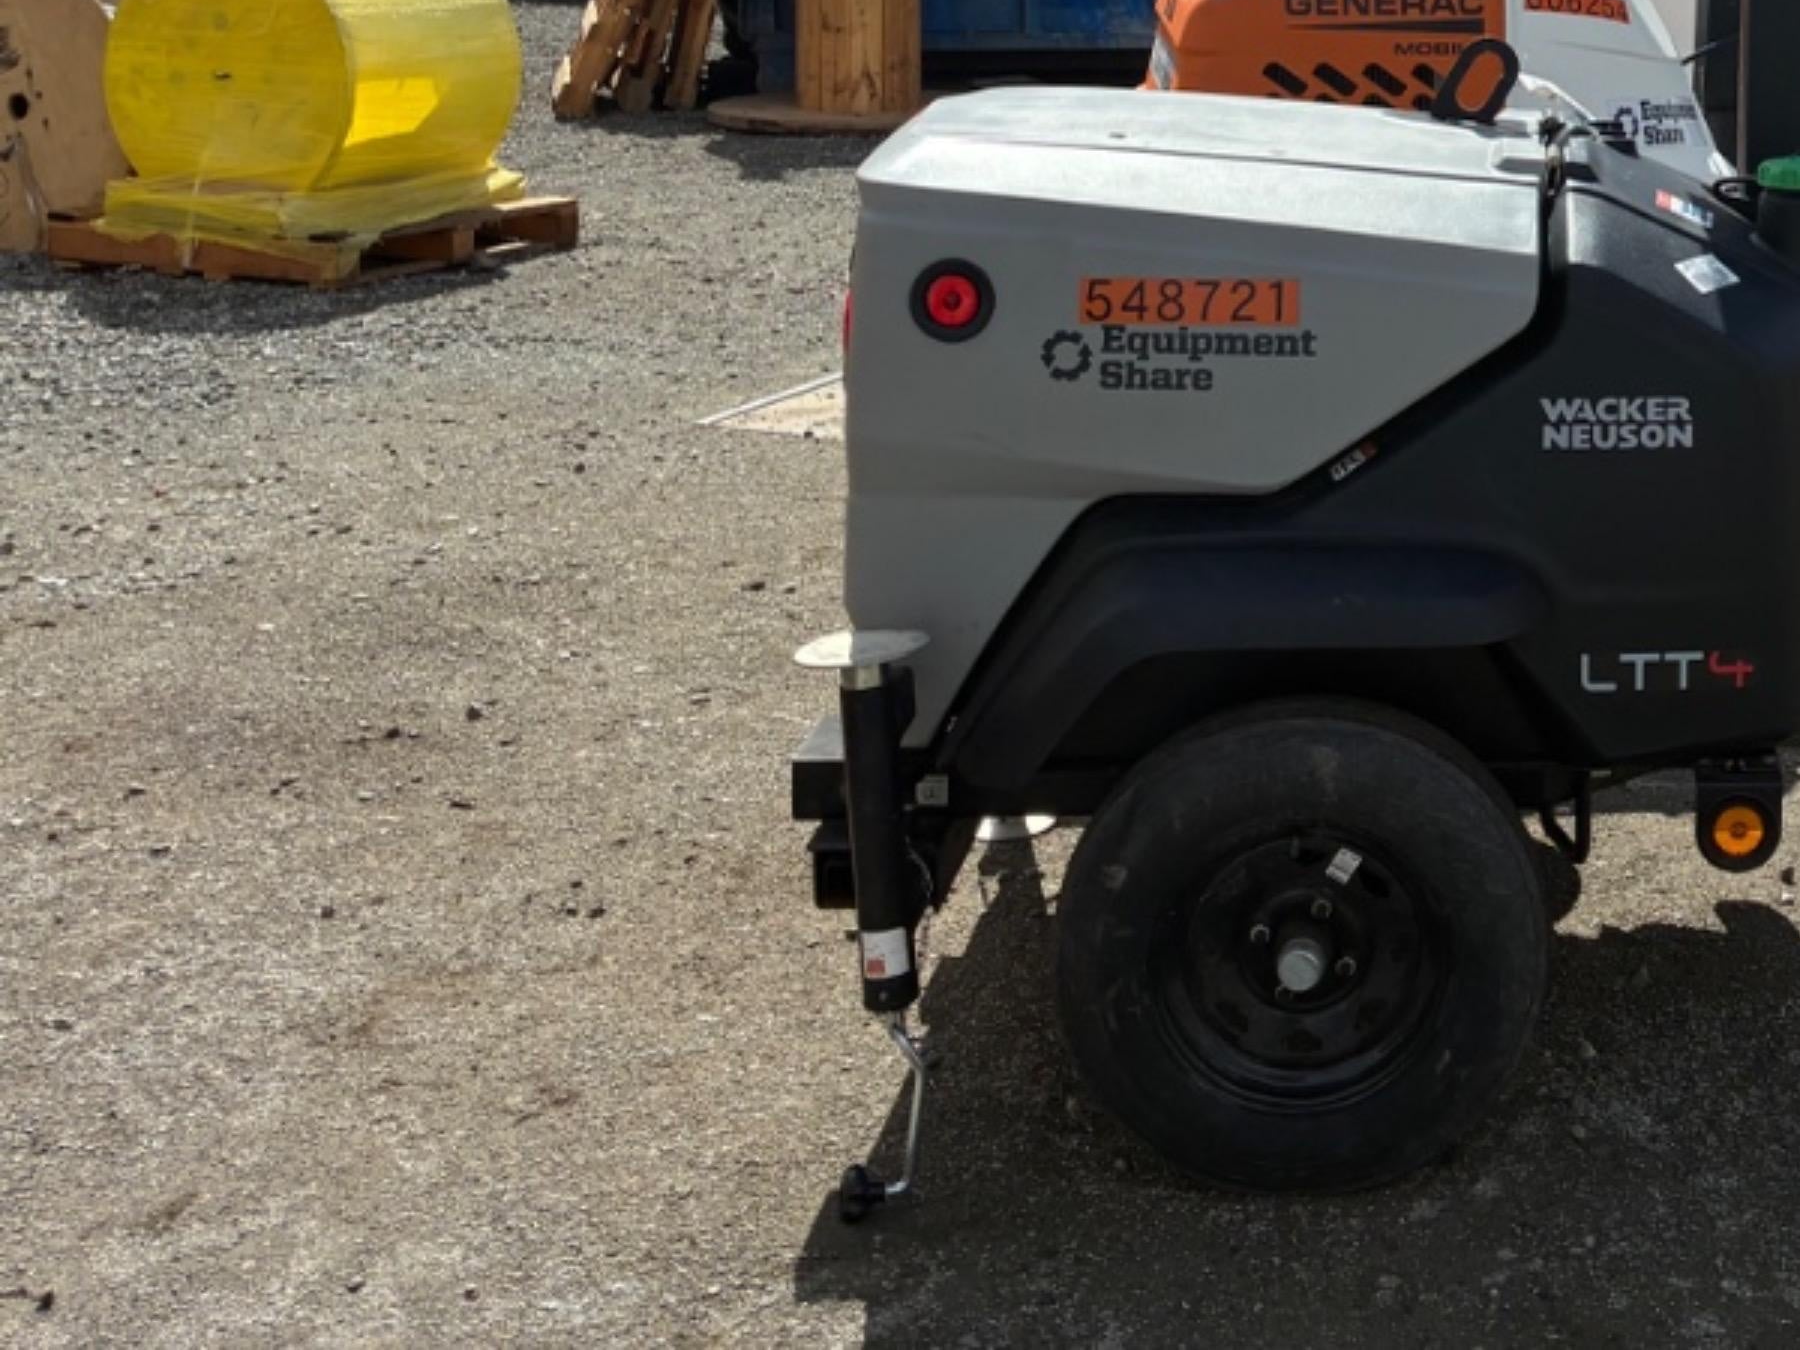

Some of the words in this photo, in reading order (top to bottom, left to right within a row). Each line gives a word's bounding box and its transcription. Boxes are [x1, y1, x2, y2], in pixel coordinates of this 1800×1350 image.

[1085, 280, 1284, 322] 548721
[1101, 325, 1317, 361] Equipment
[1099, 359, 1213, 390] Share
[1539, 397, 1693, 422] WACKER
[1541, 424, 1694, 449] NEUSON
[1580, 650, 1754, 692] LTT4
